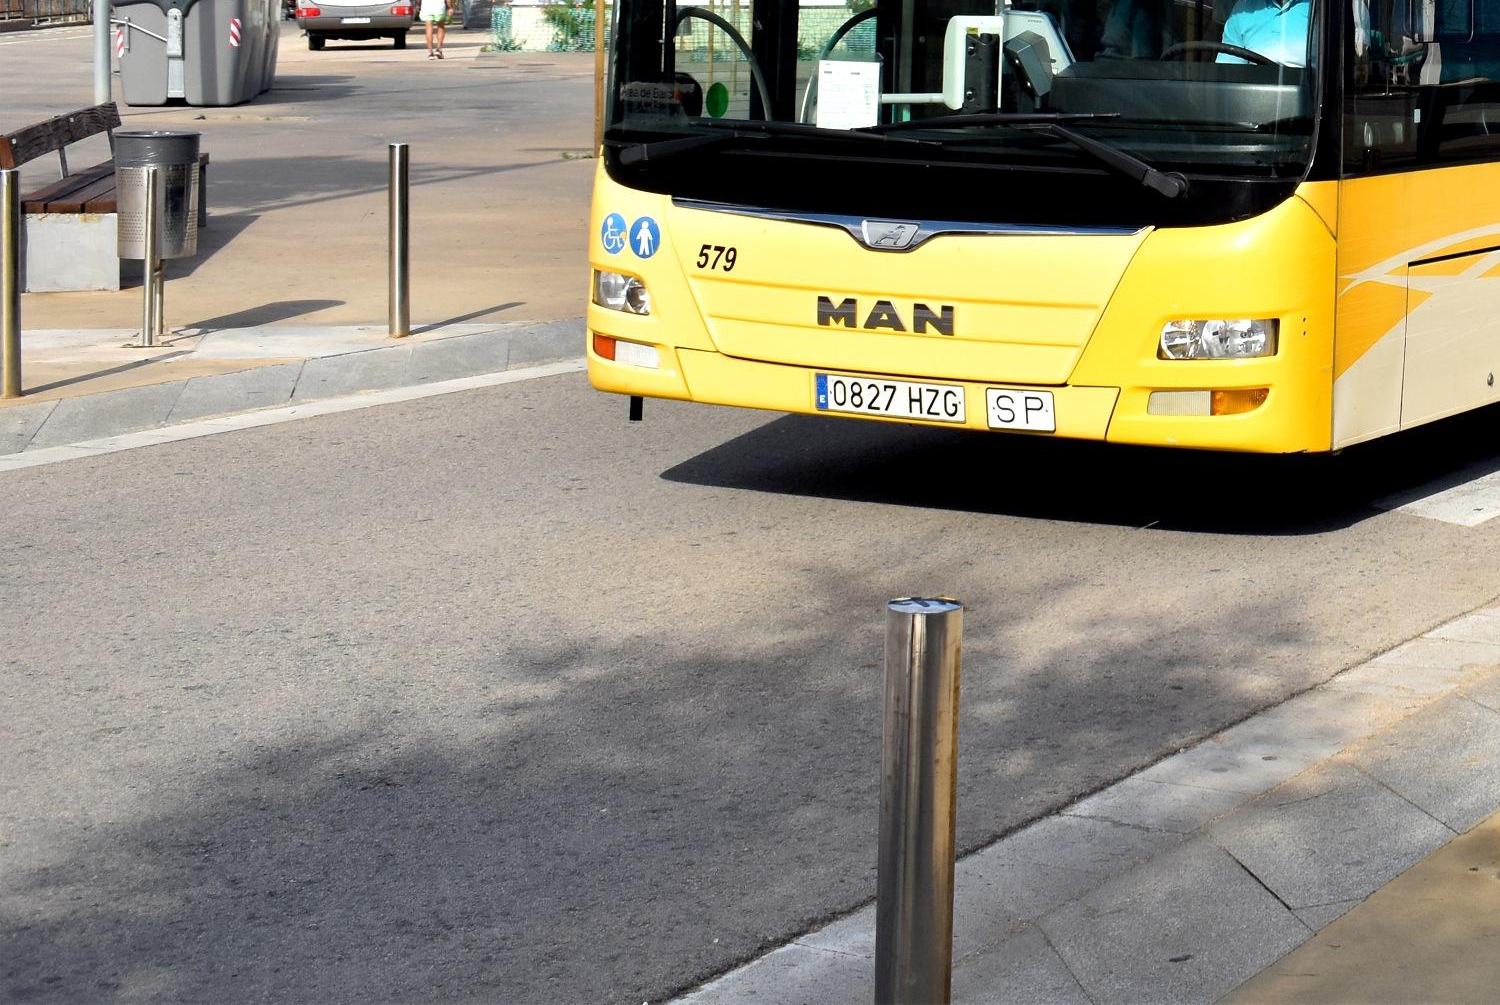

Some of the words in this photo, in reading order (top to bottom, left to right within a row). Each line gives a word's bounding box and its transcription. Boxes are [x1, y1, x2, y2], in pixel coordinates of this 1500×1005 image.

[697, 244, 737, 272] 579
[817, 296, 954, 336] MAN
[819, 394, 826, 403] E
[833, 380, 897, 411] 0827
[908, 386, 958, 417] HZG
